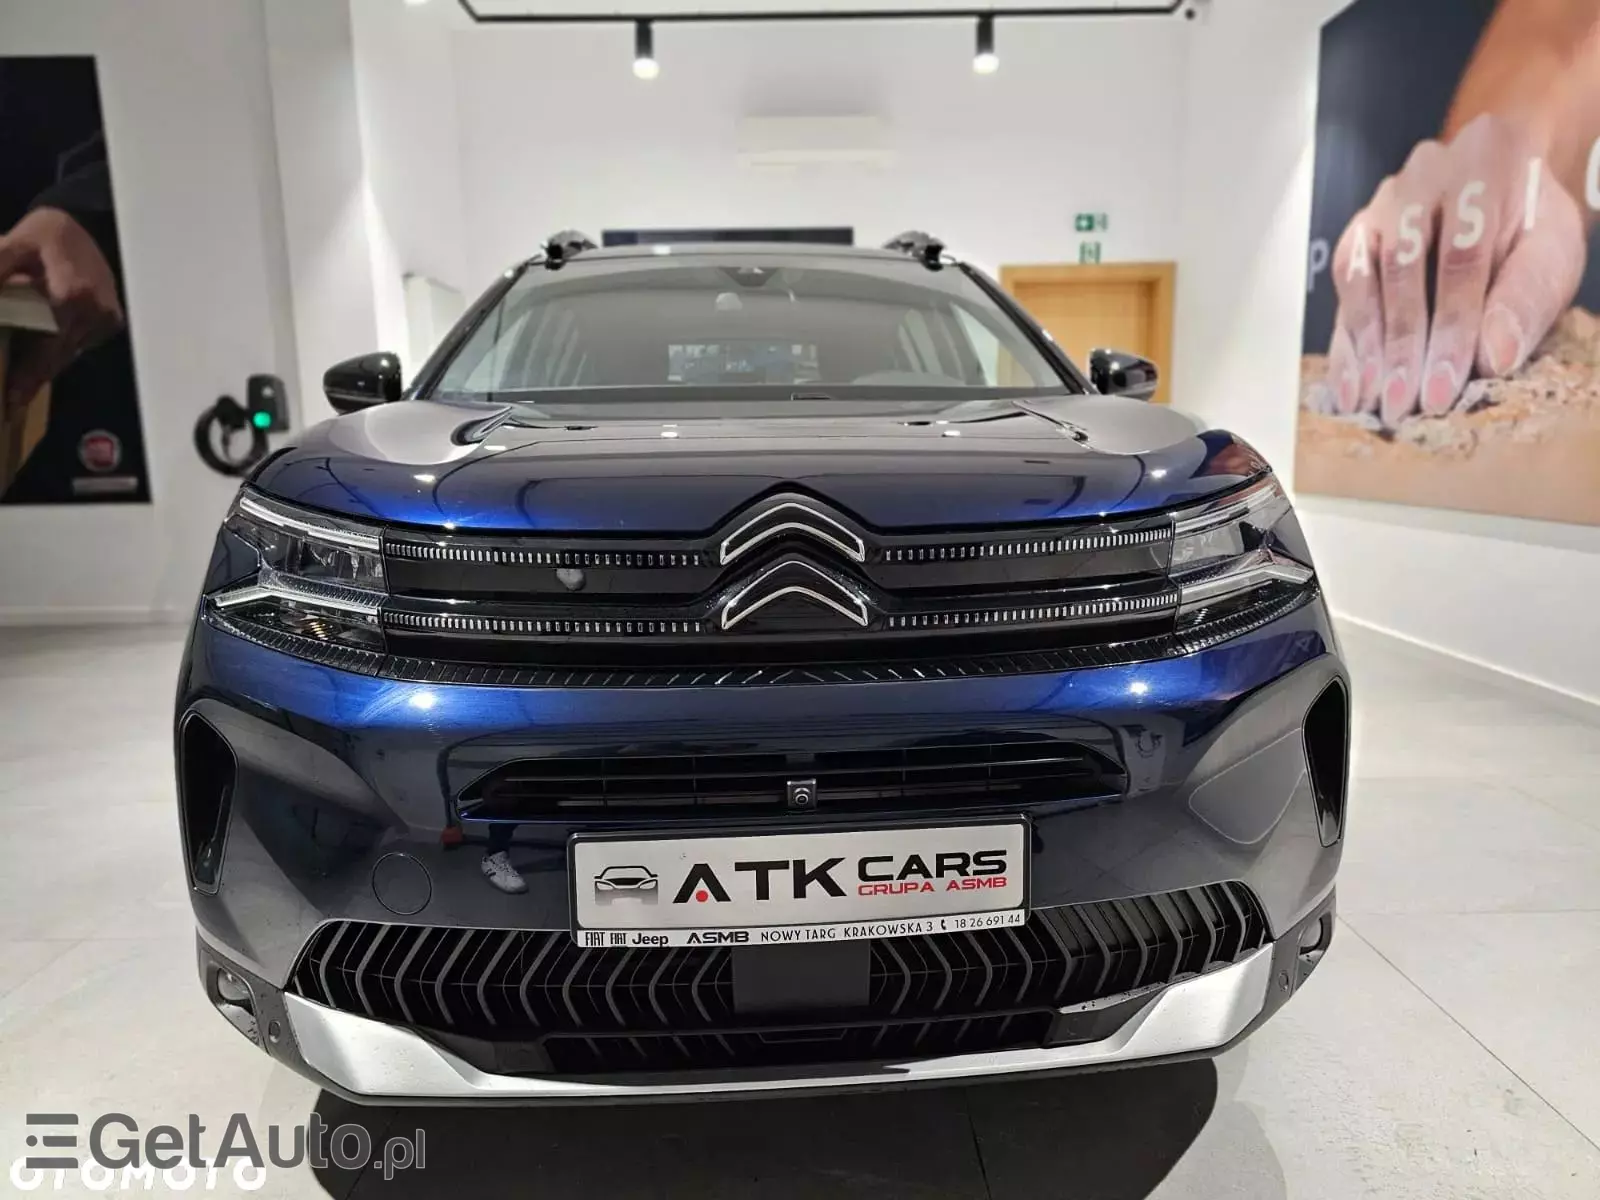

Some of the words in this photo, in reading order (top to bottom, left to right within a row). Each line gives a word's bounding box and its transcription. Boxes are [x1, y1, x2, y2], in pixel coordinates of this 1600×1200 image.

[673, 857, 847, 903] ATK
[858, 849, 1007, 882] CARS
[858, 881, 935, 896] GRUPA
[946, 876, 1007, 891] ASMB
[585, 931, 605, 946] FIAT
[610, 932, 628, 945] FIAT
[632, 932, 669, 947] Jeep
[686, 930, 750, 945] ASMB
[761, 928, 801, 942] NOWY
[805, 927, 836, 940] TARG
[843, 921, 922, 938] KRAKOWSKA
[926, 920, 934, 932] 3
[954, 918, 967, 929] 18
[969, 916, 984, 928] 26
[985, 914, 1004, 926] 691
[1007, 913, 1021, 924] 44
